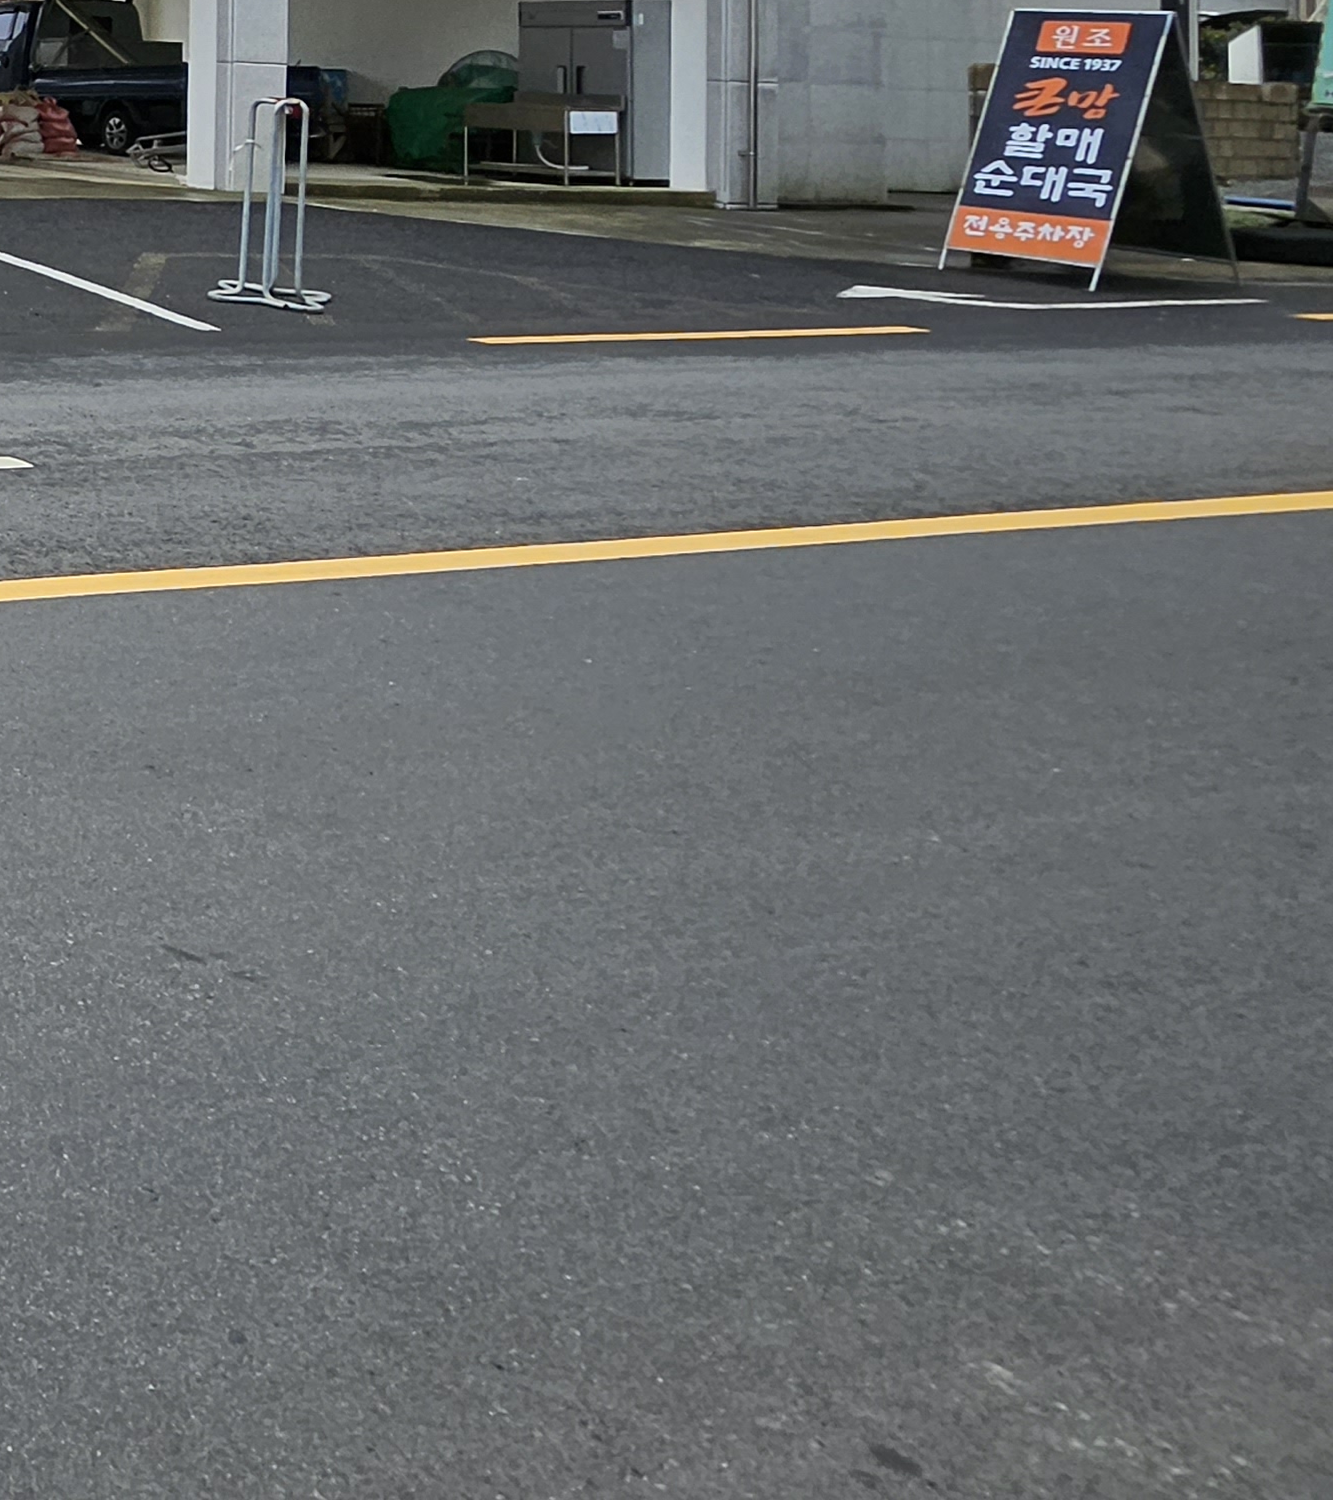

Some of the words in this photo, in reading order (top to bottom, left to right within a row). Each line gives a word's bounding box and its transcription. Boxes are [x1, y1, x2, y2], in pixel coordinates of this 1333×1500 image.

[1052, 25, 1113, 49] 원조
[1029, 56, 1080, 70] SINCE
[1083, 58, 1122, 71] 1937
[1003, 122, 1105, 164] 할매
[973, 159, 1113, 208] 순대국
[963, 214, 1095, 248] 전용주차장
